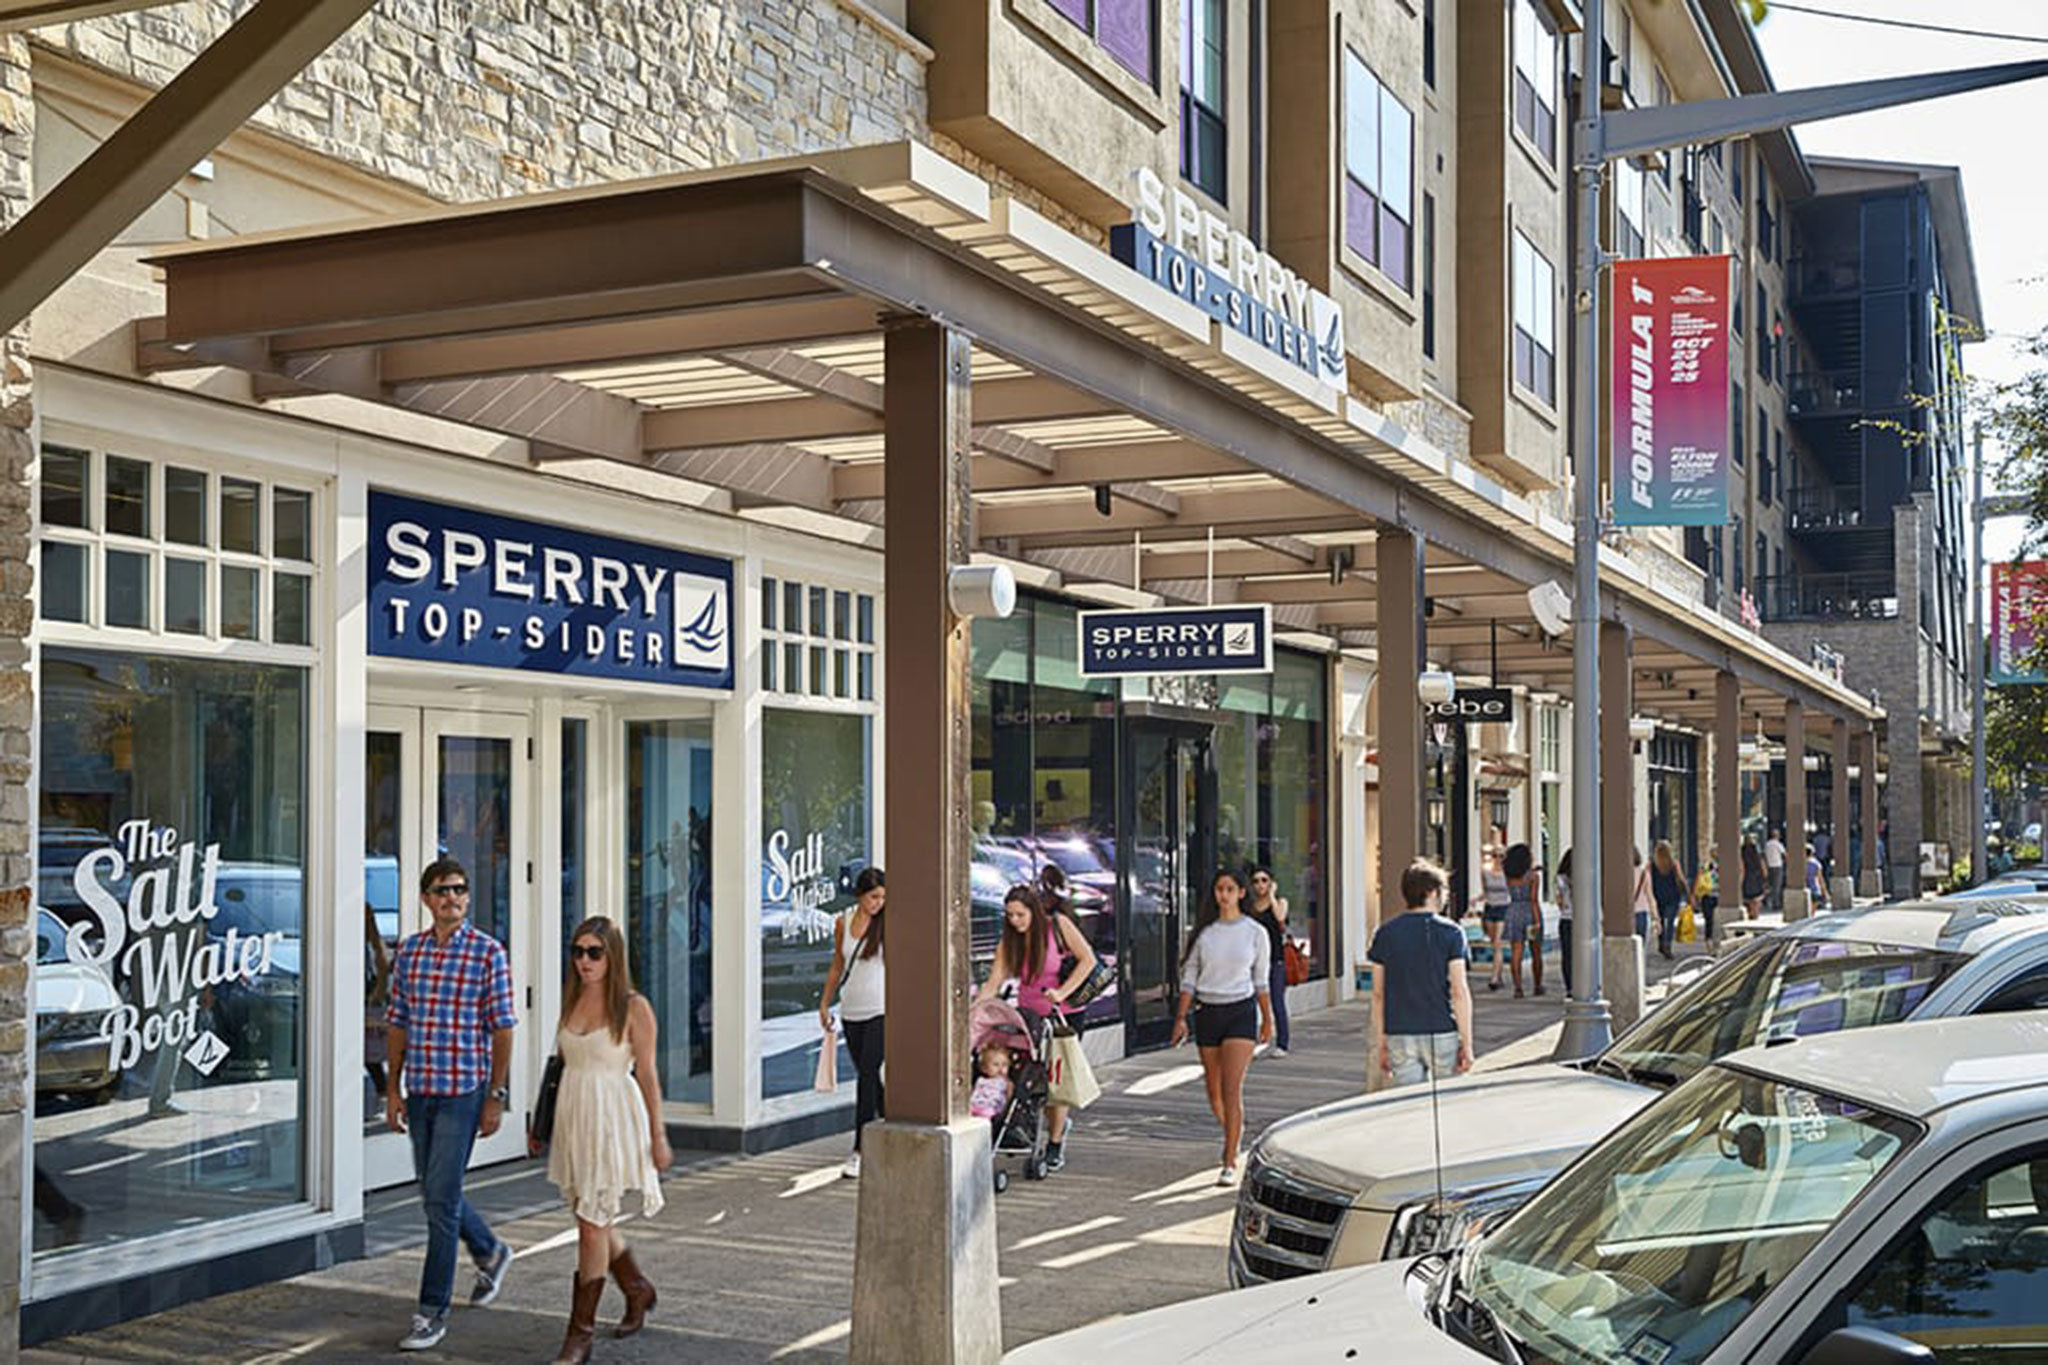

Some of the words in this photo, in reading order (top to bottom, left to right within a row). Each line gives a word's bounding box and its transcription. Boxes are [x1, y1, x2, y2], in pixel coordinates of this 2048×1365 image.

[1138, 167, 1308, 330] SPERRY
[1151, 243, 1310, 366] TOP-SIDER
[1672, 337, 1714, 349] OCT
[1631, 315, 1653, 508] FORMULA
[386, 521, 666, 615] SPERRY
[390, 599, 664, 663] TOP-SIDER
[1092, 624, 1219, 645] SPERRY
[1094, 646, 1218, 660] TOP-SIDER
[118, 819, 177, 862] The
[767, 829, 823, 901] Salt
[65, 841, 222, 965] Salt
[122, 927, 283, 1009] Water
[100, 996, 201, 1072] Boot
